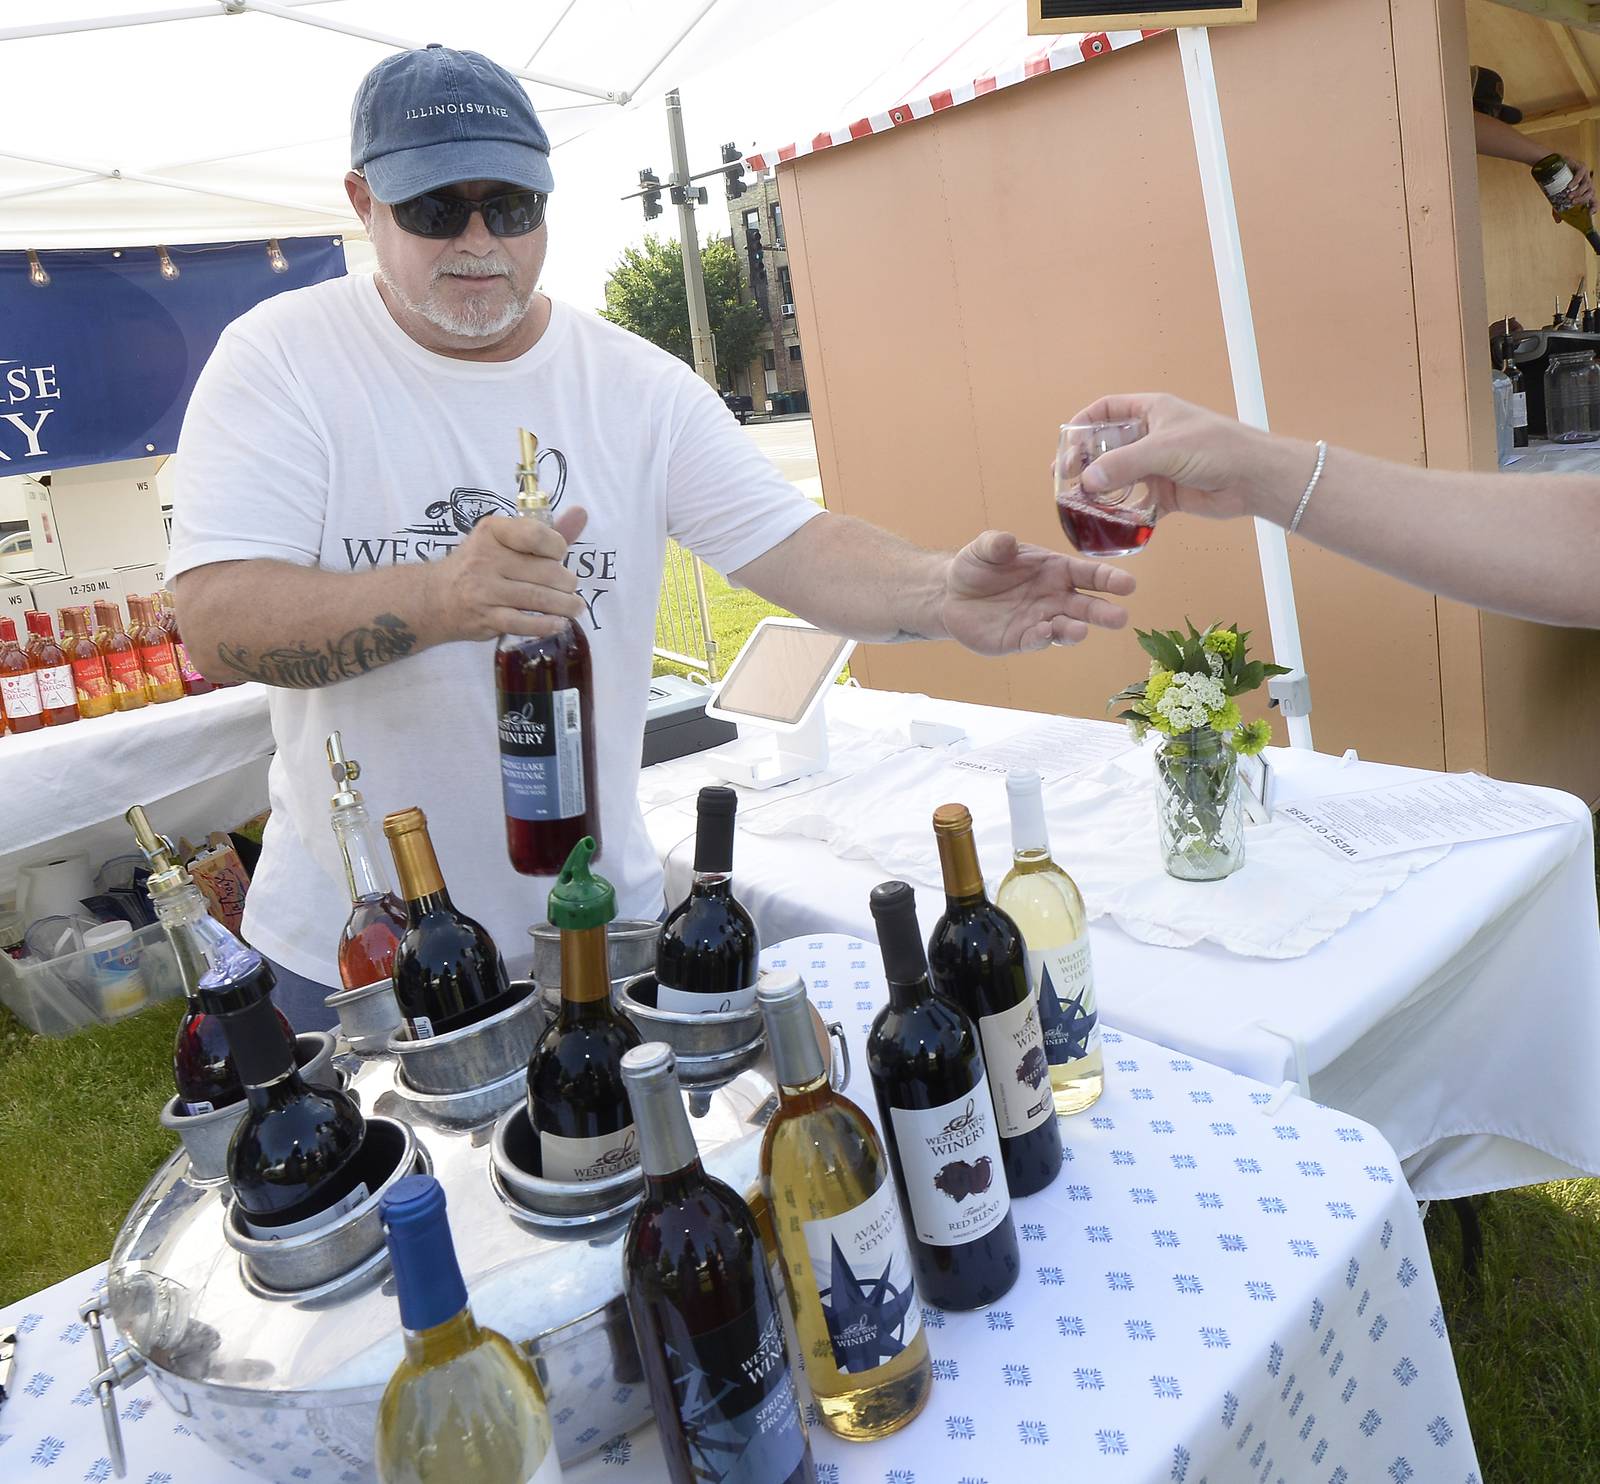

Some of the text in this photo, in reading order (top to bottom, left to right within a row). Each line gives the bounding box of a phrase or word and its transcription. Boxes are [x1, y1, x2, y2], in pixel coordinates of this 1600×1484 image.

[0, 364, 60, 405] SE
[136, 482, 149, 491] W5
[563, 548, 617, 581] ISE
[155, 572, 164, 581] 12
[69, 581, 111, 595] 12-750 ML
[1285, 807, 1358, 857] WEST OF WISE
[925, 1133, 953, 1145] WEST
[931, 1124, 985, 1156] WINERY
[574, 1166, 605, 1177] WEST
[837, 1331, 877, 1347] WINERY
